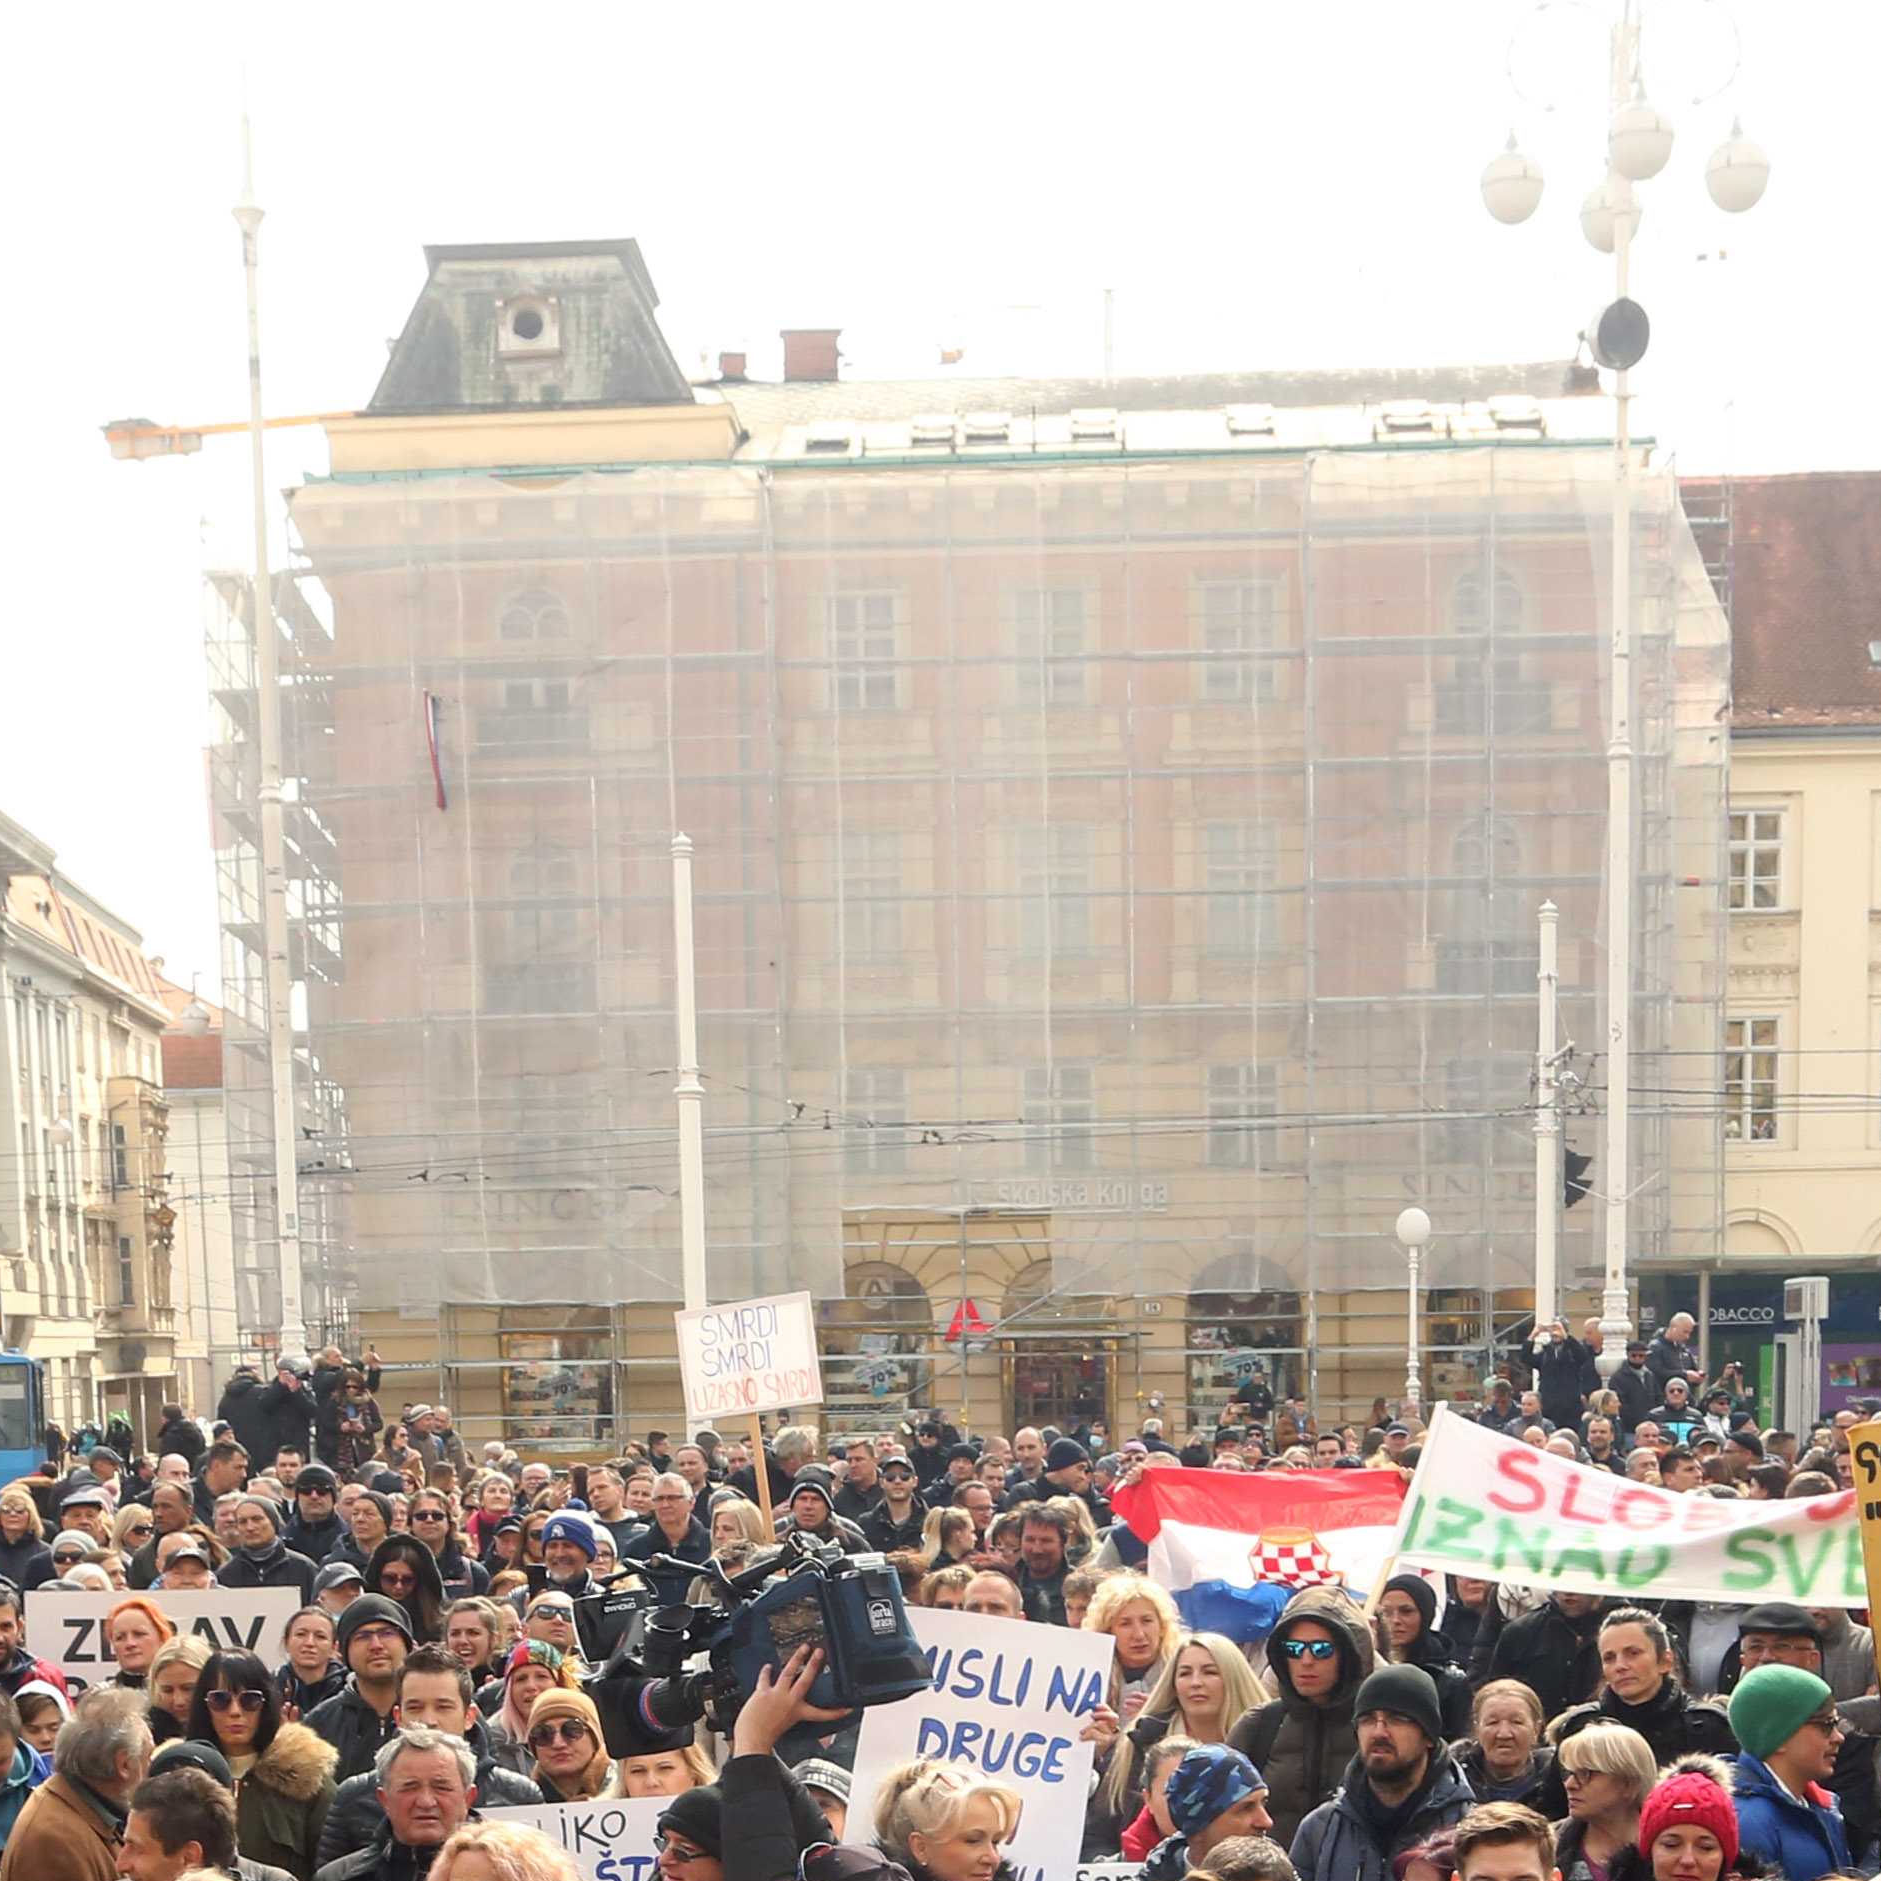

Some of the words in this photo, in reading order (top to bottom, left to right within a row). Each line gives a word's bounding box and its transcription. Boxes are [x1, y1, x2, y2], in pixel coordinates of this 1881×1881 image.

[700, 1304, 778, 1346] SMRDI
[701, 1339, 772, 1377] SMRDI
[763, 1367, 815, 1404] SMRDI
[1044, 1664, 1103, 1718] NA
[916, 1717, 1073, 1783] DRUGE
